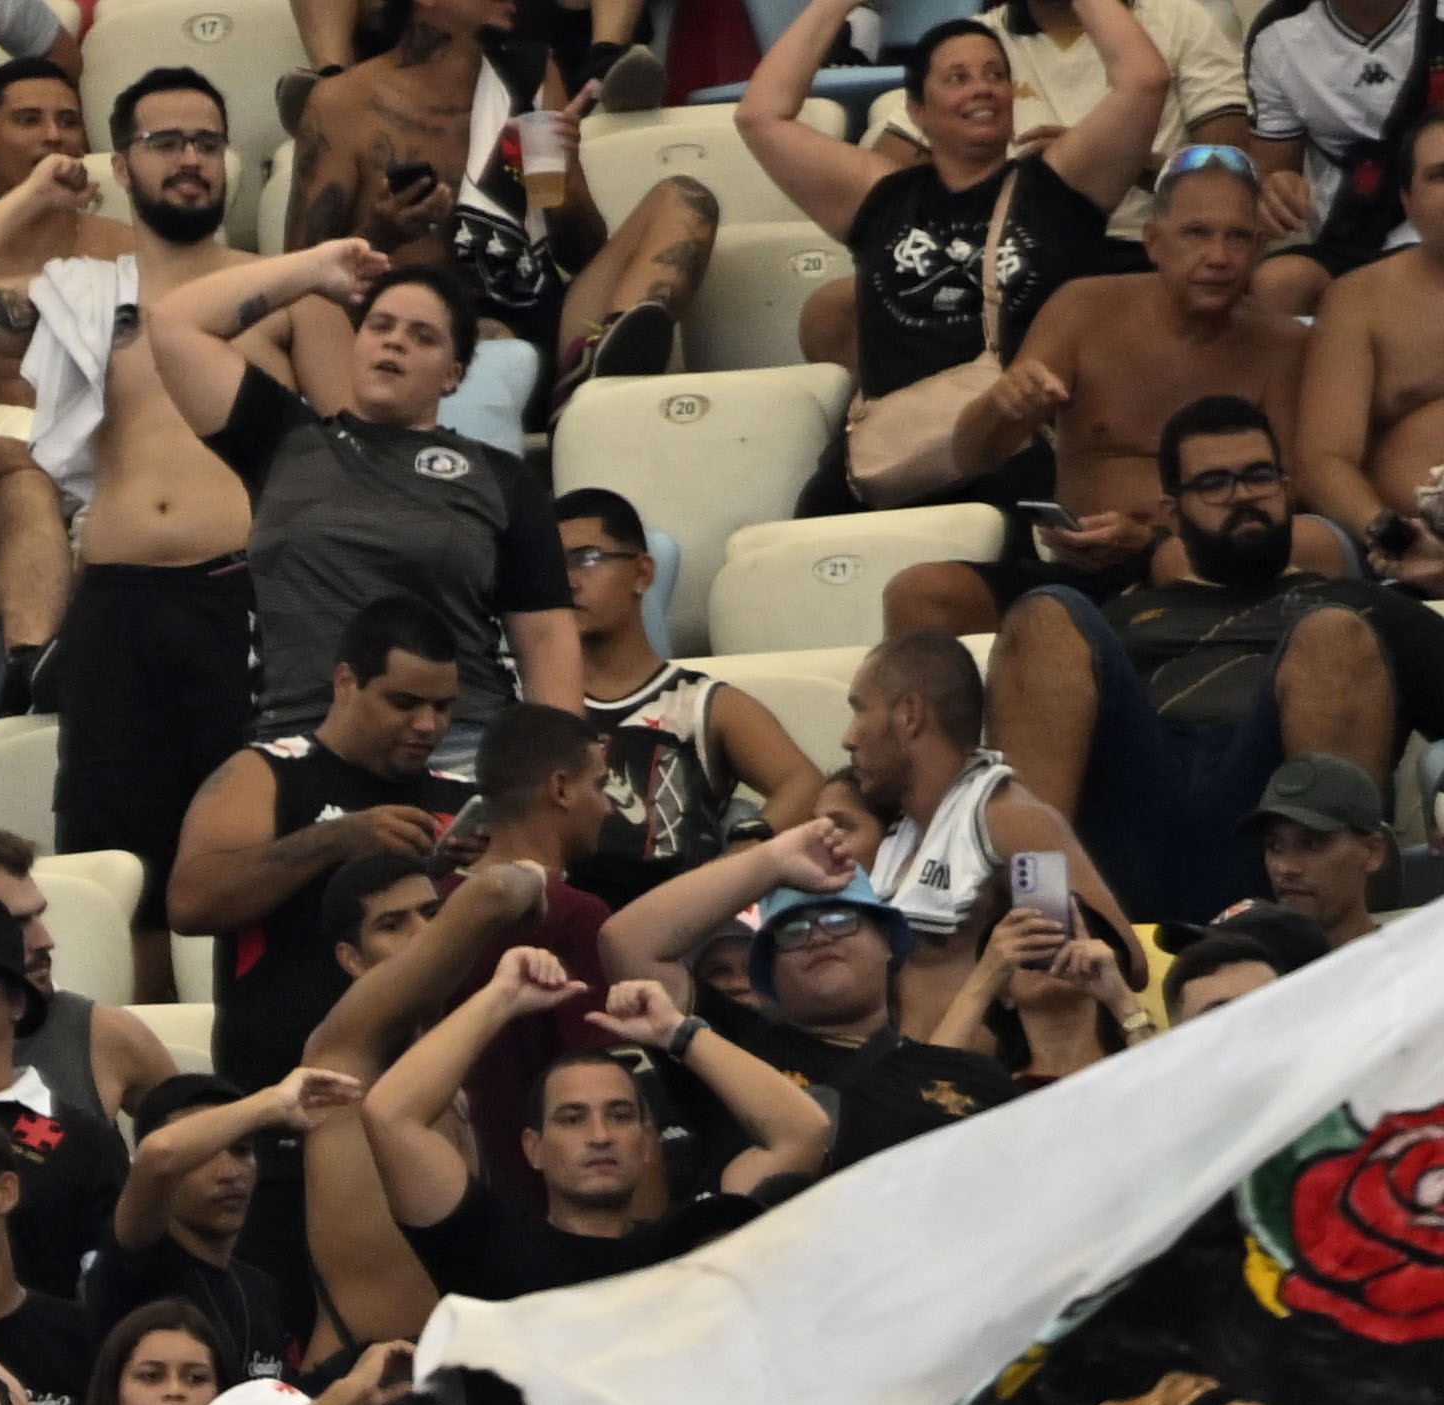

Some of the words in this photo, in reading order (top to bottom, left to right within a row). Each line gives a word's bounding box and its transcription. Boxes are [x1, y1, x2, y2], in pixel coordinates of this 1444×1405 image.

[201, 21, 218, 35] 17
[803, 257, 822, 271] 20
[676, 402, 696, 415] 20
